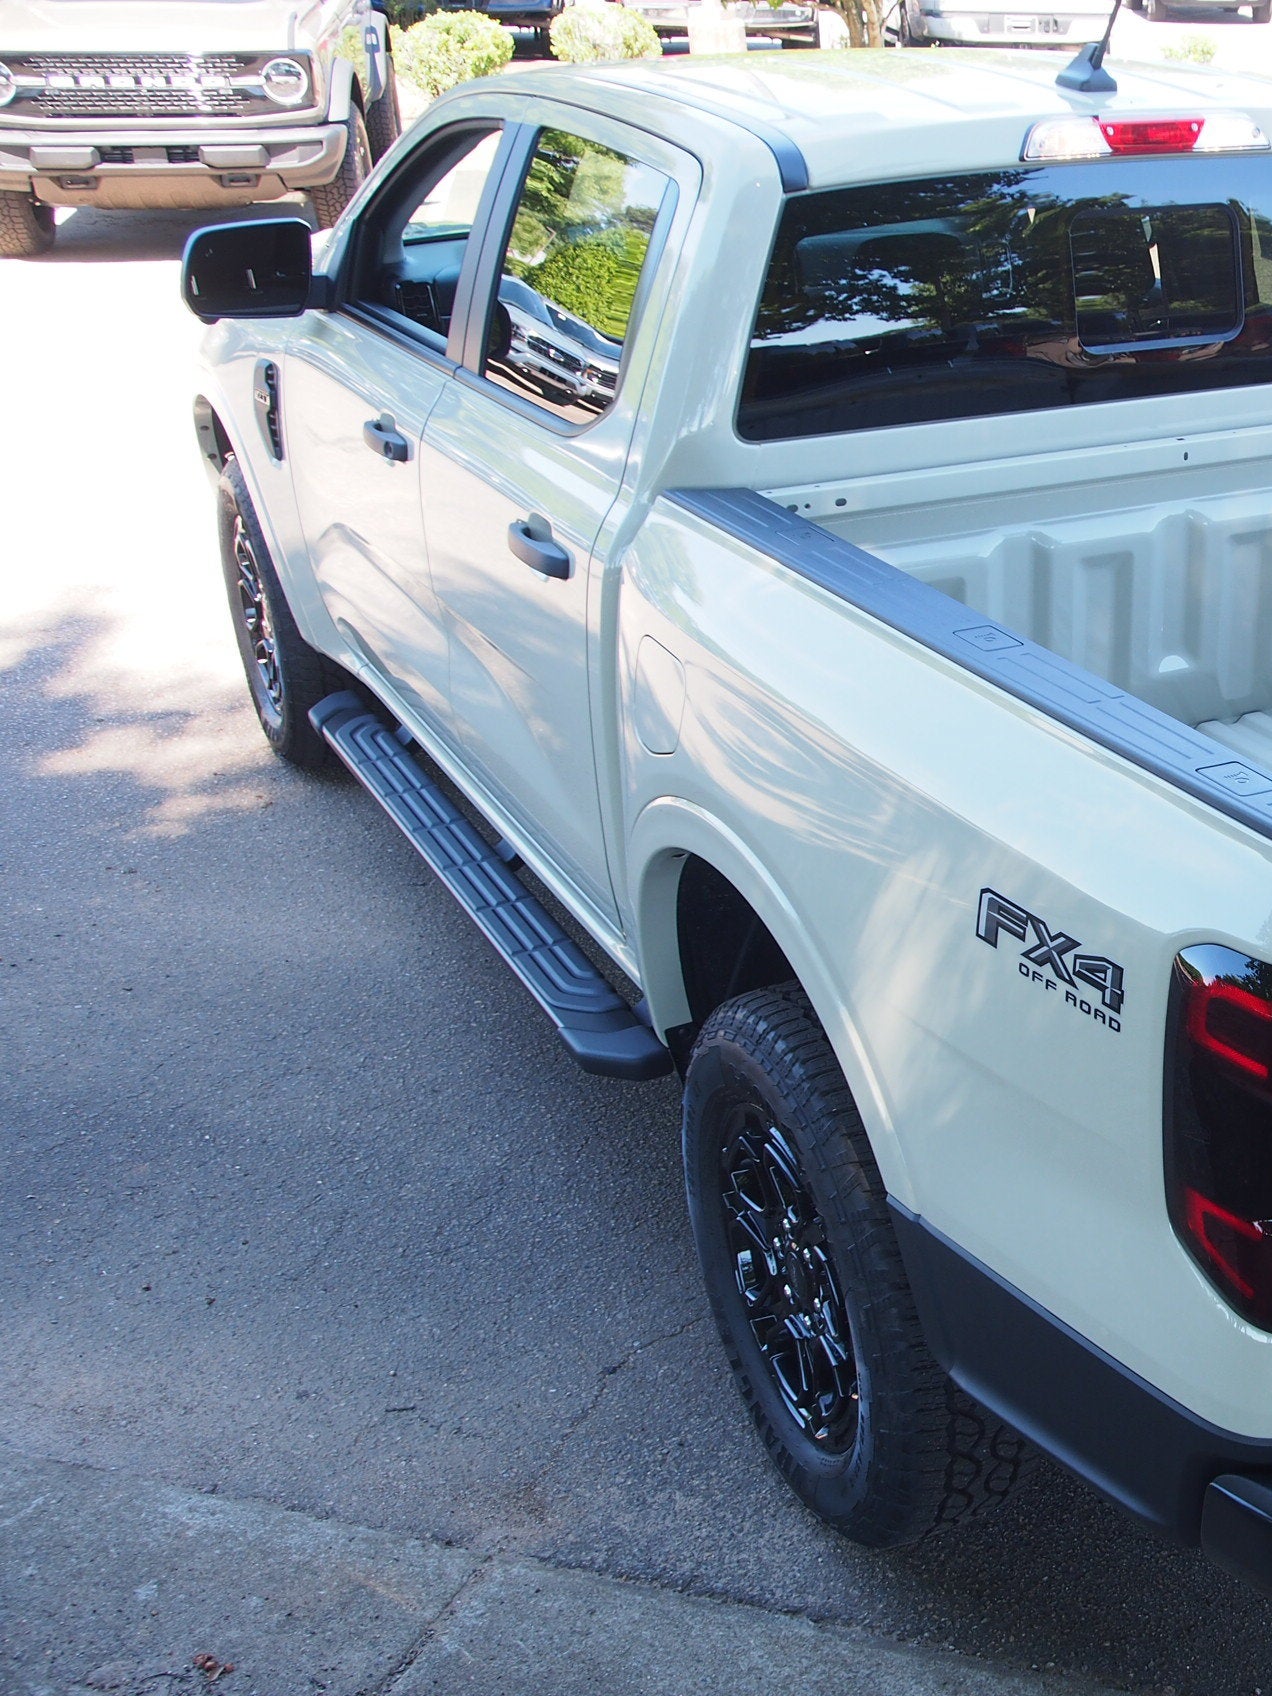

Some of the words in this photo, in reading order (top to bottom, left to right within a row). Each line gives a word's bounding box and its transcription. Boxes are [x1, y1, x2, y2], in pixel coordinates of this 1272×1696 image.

[975, 887, 1125, 1015] FX4
[1018, 962, 1058, 991] OFF
[1064, 990, 1121, 1033] ROAD
